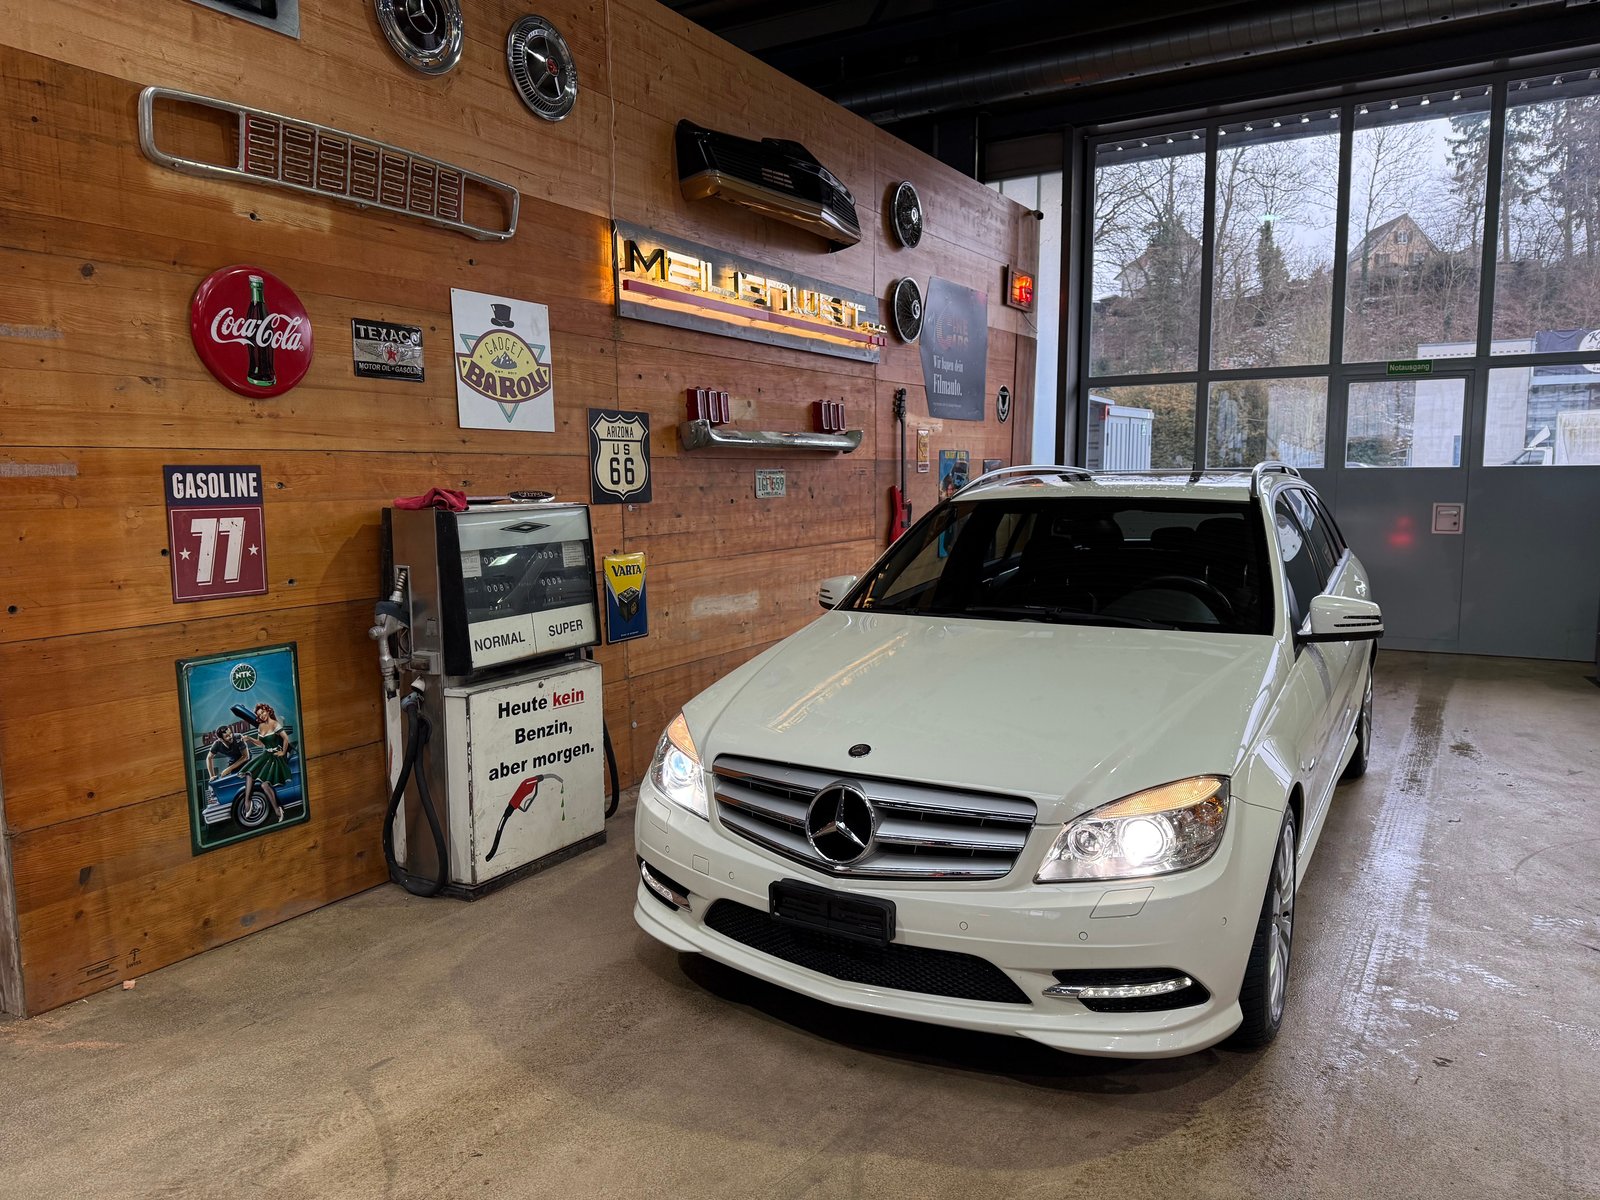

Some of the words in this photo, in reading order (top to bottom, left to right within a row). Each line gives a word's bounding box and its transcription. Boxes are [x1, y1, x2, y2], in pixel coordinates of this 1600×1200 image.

[210, 307, 304, 351] Coca-Cola
[355, 324, 421, 344] TEXACO
[484, 336, 524, 358] GADGET
[358, 362, 381, 371] MOTOR
[382, 364, 391, 372] OIL
[394, 366, 422, 375] GASOLINE
[464, 359, 549, 399] BARON
[933, 373, 963, 396] Filmauto.
[606, 425, 634, 438] ARIZONA
[609, 457, 635, 485] 66
[171, 472, 259, 499] GASOLINE
[190, 516, 246, 585] 77
[611, 564, 642, 577] VARTA
[548, 619, 584, 637] SUPER
[474, 630, 526, 652] NORMAL
[235, 670, 252, 679] NTK
[498, 696, 548, 719] Heute
[552, 688, 585, 708] kein
[515, 719, 573, 745] Benzin,
[488, 758, 528, 781] aber
[532, 742, 595, 769] morgen.
